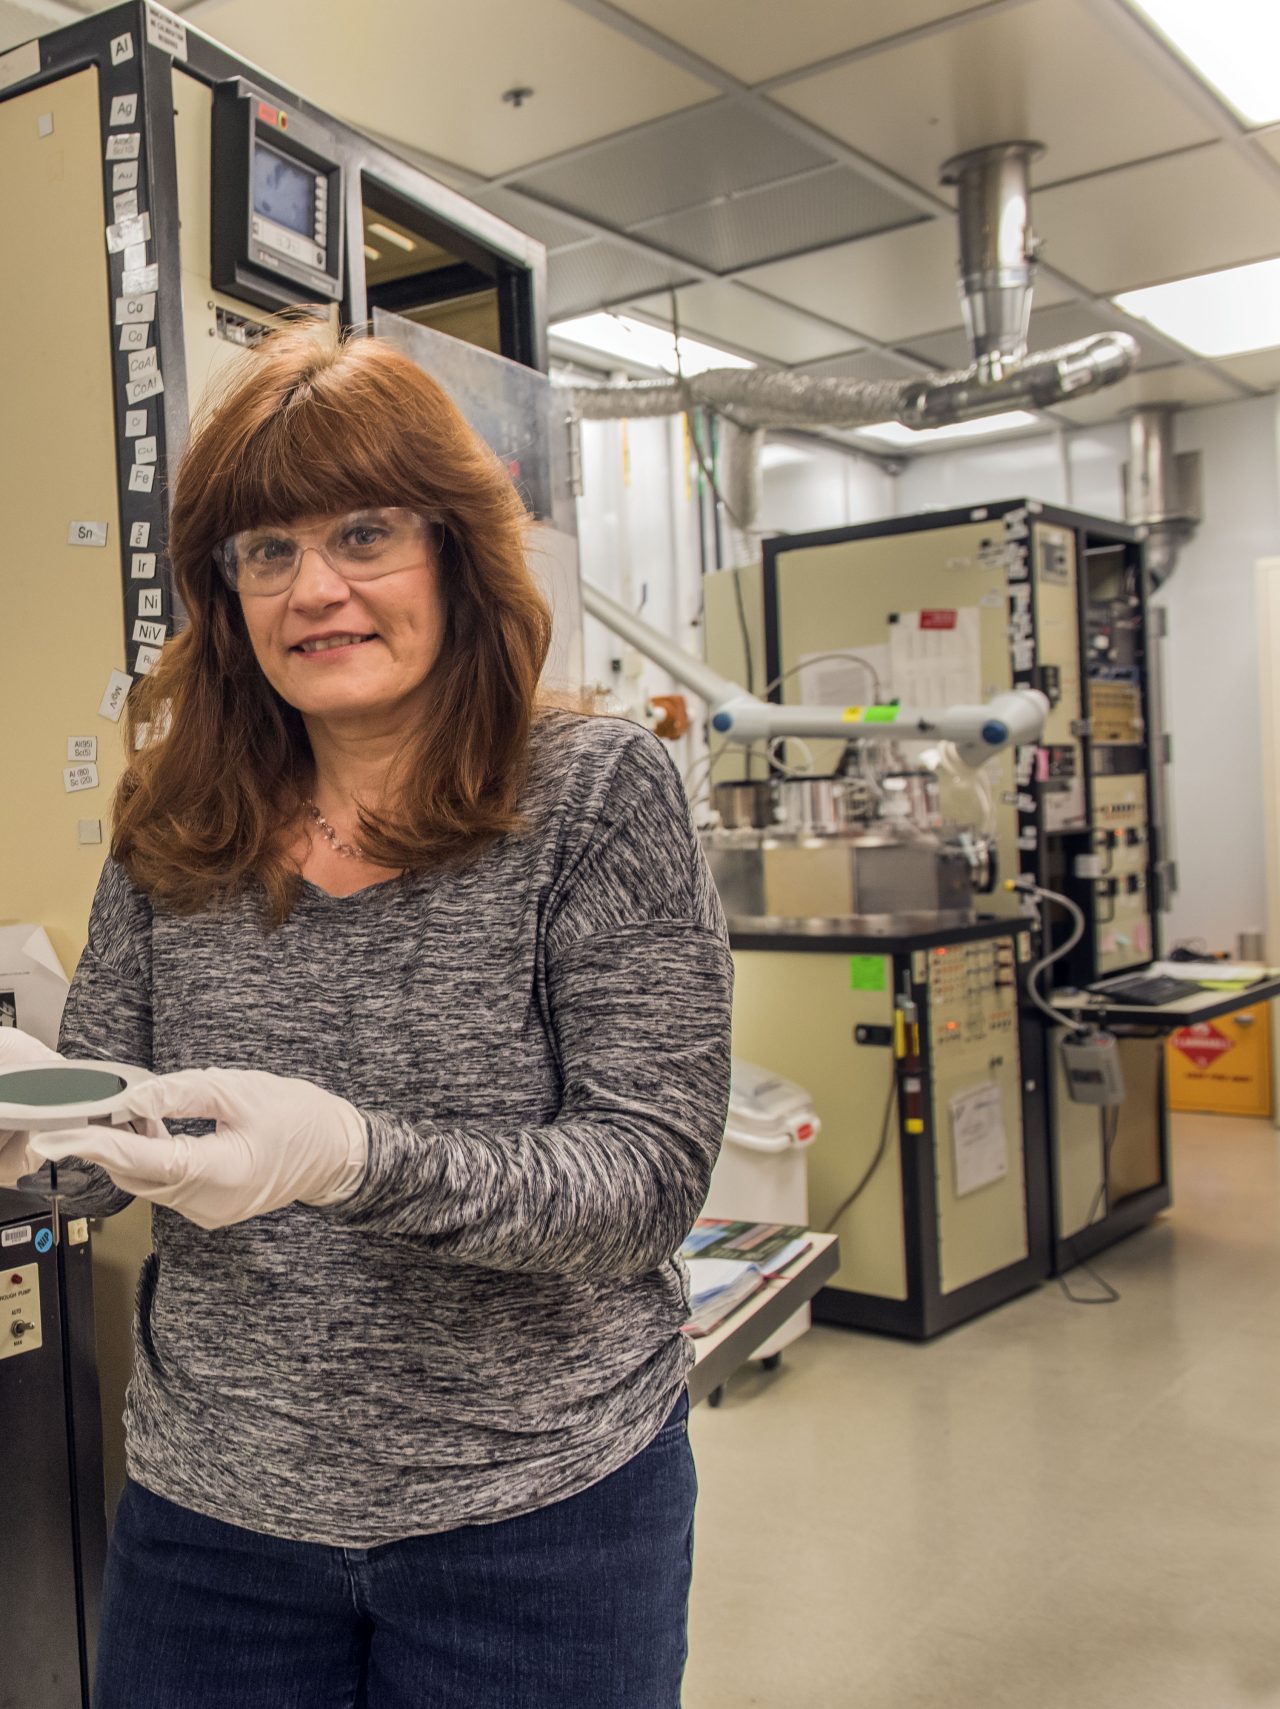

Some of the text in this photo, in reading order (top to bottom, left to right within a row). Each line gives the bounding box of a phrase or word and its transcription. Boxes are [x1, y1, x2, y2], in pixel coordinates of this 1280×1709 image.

[116, 37, 128, 57] Al
[117, 102, 133, 117] Ag
[127, 301, 143, 314] Co
[128, 330, 143, 342] Co
[130, 355, 155, 372] CoAl
[133, 377, 157, 397] CoAl
[135, 470, 150, 484] Fe
[78, 526, 93, 539] Sn
[138, 559, 147, 573] Ir
[144, 594, 158, 609] Ni
[139, 624, 162, 641] NiV
